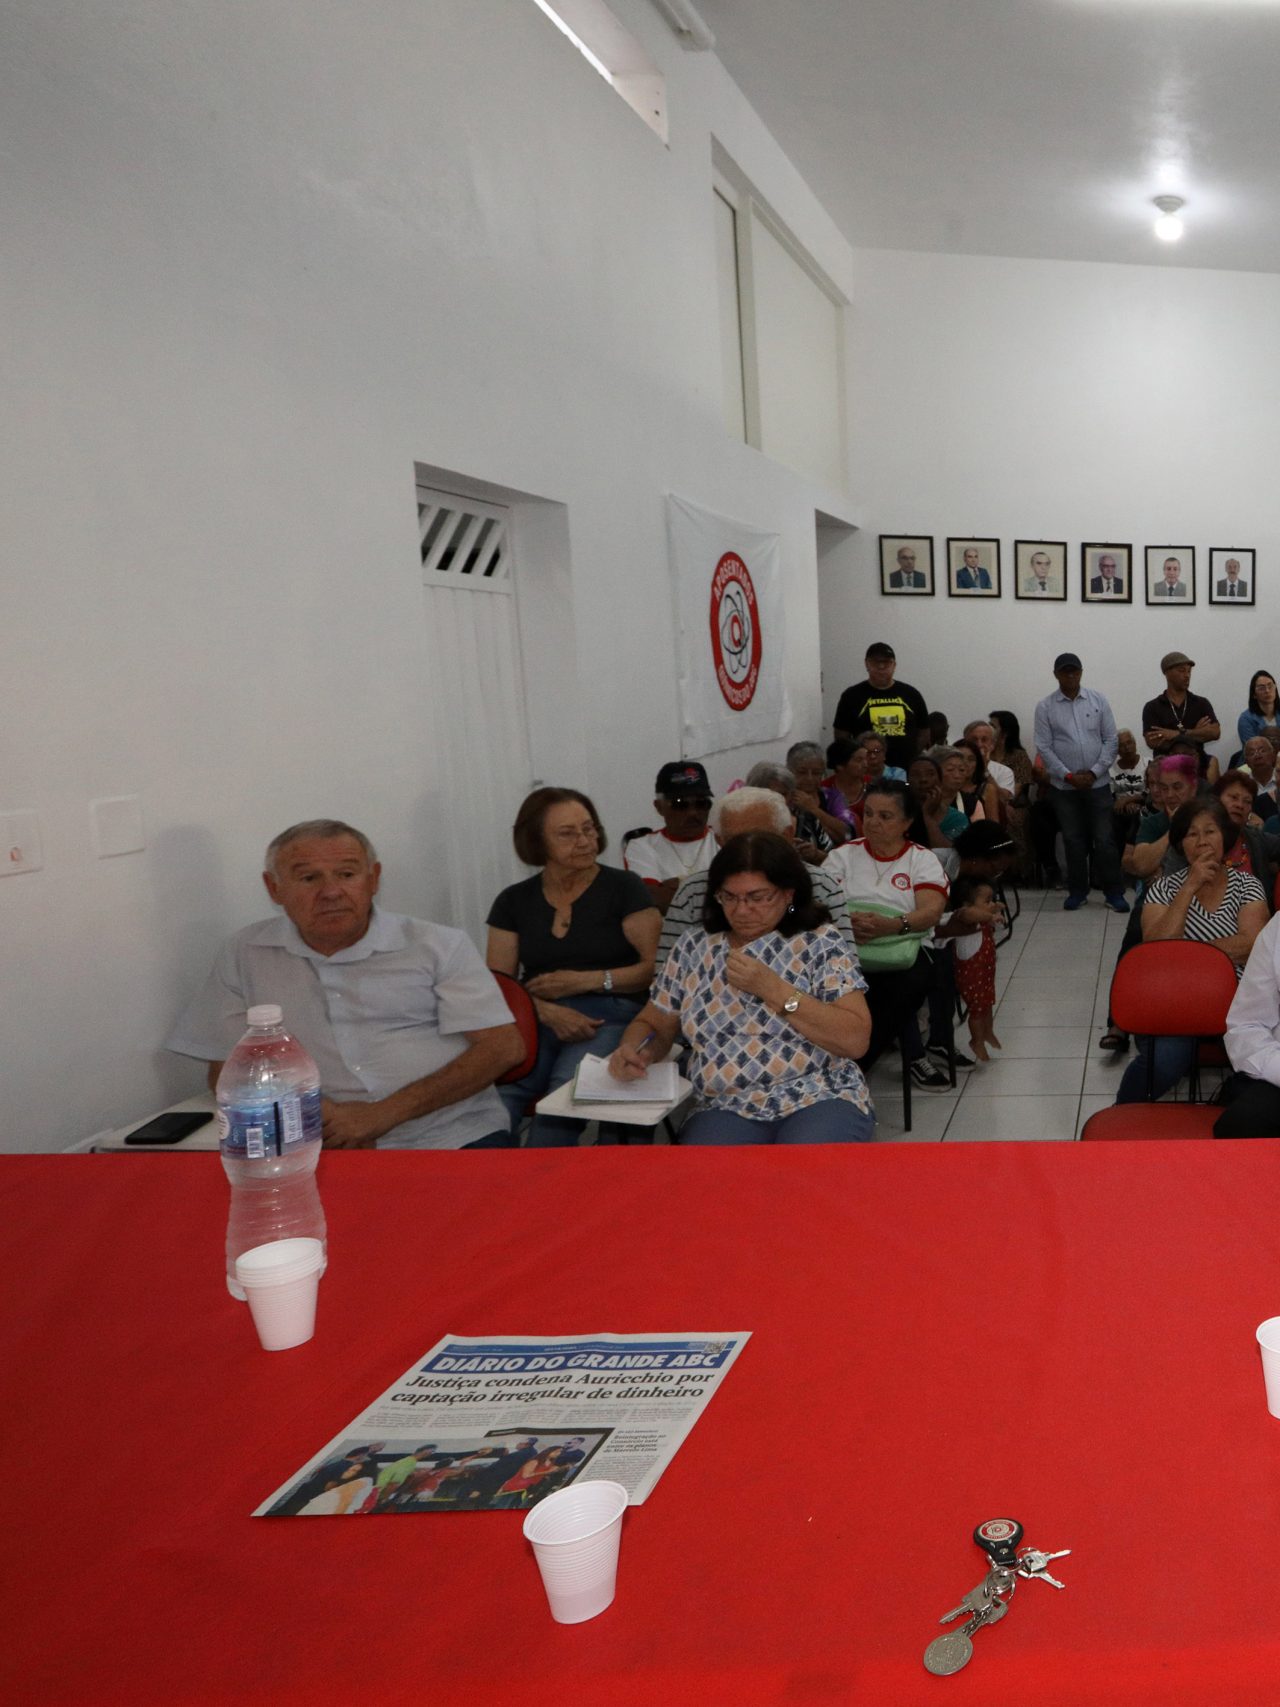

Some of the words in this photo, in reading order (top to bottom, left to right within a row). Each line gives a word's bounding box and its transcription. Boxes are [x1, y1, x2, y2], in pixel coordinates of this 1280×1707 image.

[432, 1356, 525, 1371] DIÁRIO
[524, 1356, 566, 1371] DO
[567, 1354, 666, 1369] GRANDE
[667, 1353, 720, 1367] ABC
[405, 1375, 482, 1390] Justiça
[484, 1374, 573, 1388] condena
[575, 1372, 674, 1385] Auricchio
[675, 1374, 715, 1385] por
[391, 1391, 487, 1406] captação
[488, 1387, 584, 1403] irregular
[586, 1387, 613, 1399] de
[616, 1386, 704, 1399] dinheiro
